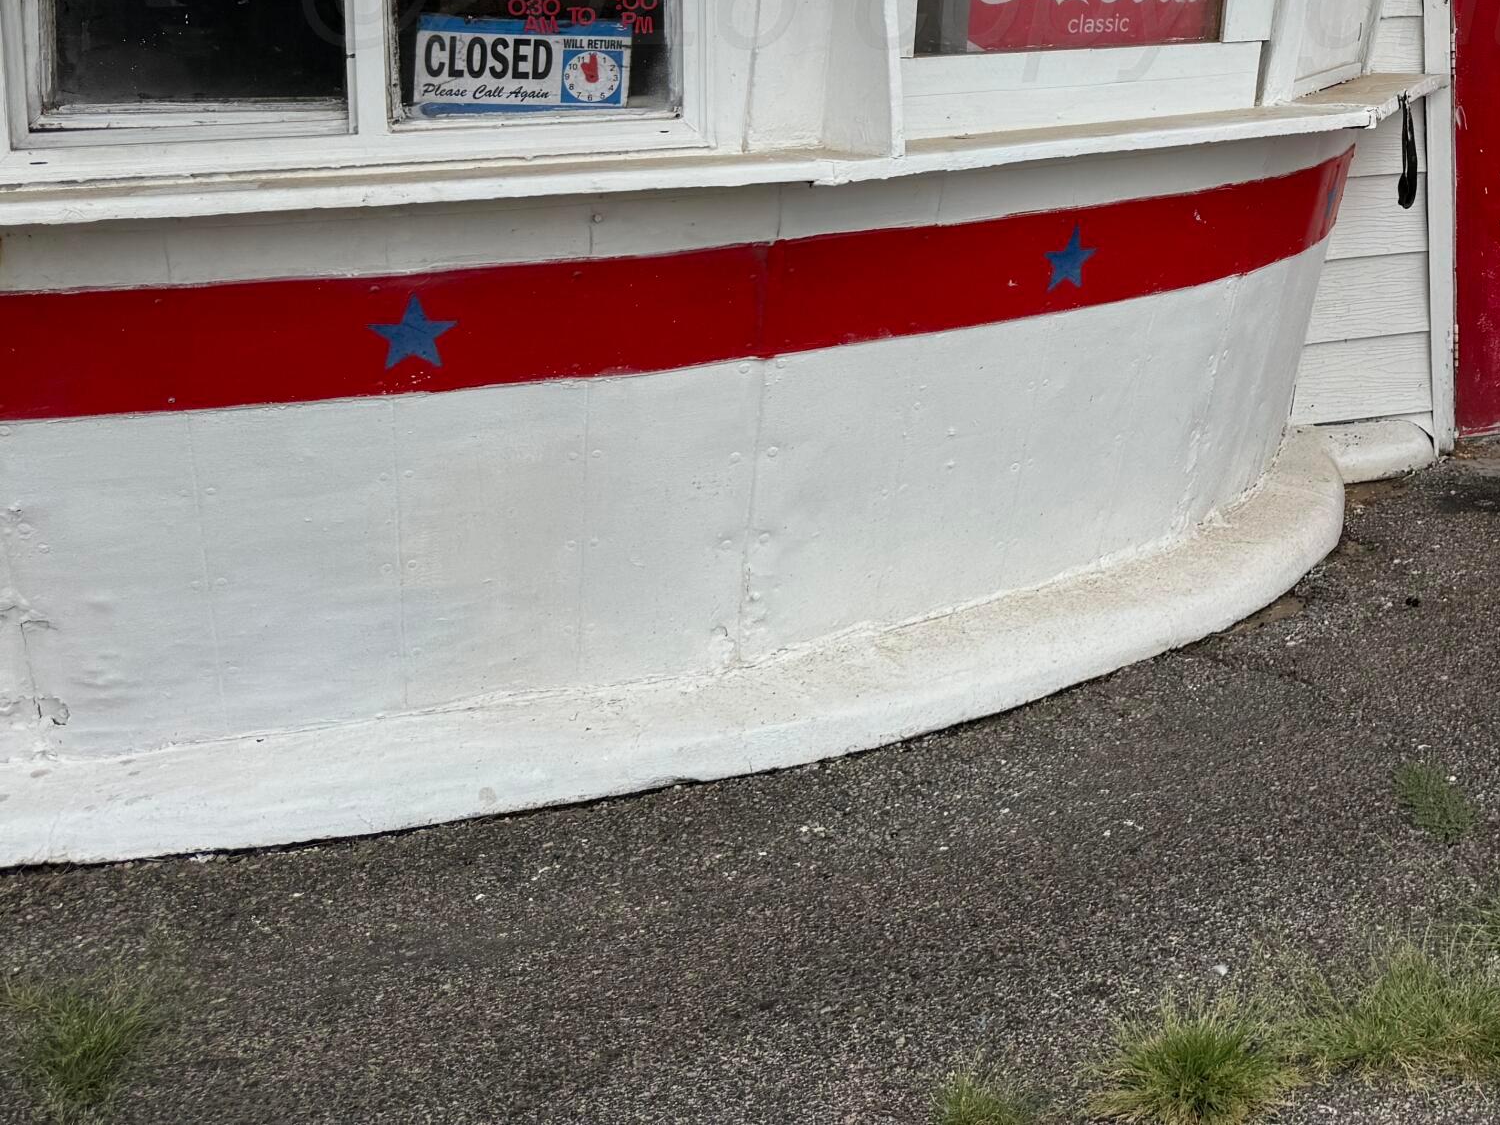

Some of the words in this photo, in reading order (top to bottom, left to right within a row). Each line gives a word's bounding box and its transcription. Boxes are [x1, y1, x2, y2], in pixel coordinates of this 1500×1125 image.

[524, 16, 559, 34] AM
[622, 12, 654, 34] PM
[567, 7, 596, 25] TO
[1068, 14, 1129, 34] classic
[563, 39, 585, 49] WILL
[587, 39, 623, 50] RETURN
[424, 34, 553, 80] CLOSED
[568, 63, 578, 71] 10
[422, 83, 467, 97] Please
[473, 84, 504, 99] Call
[507, 86, 550, 102] Again
